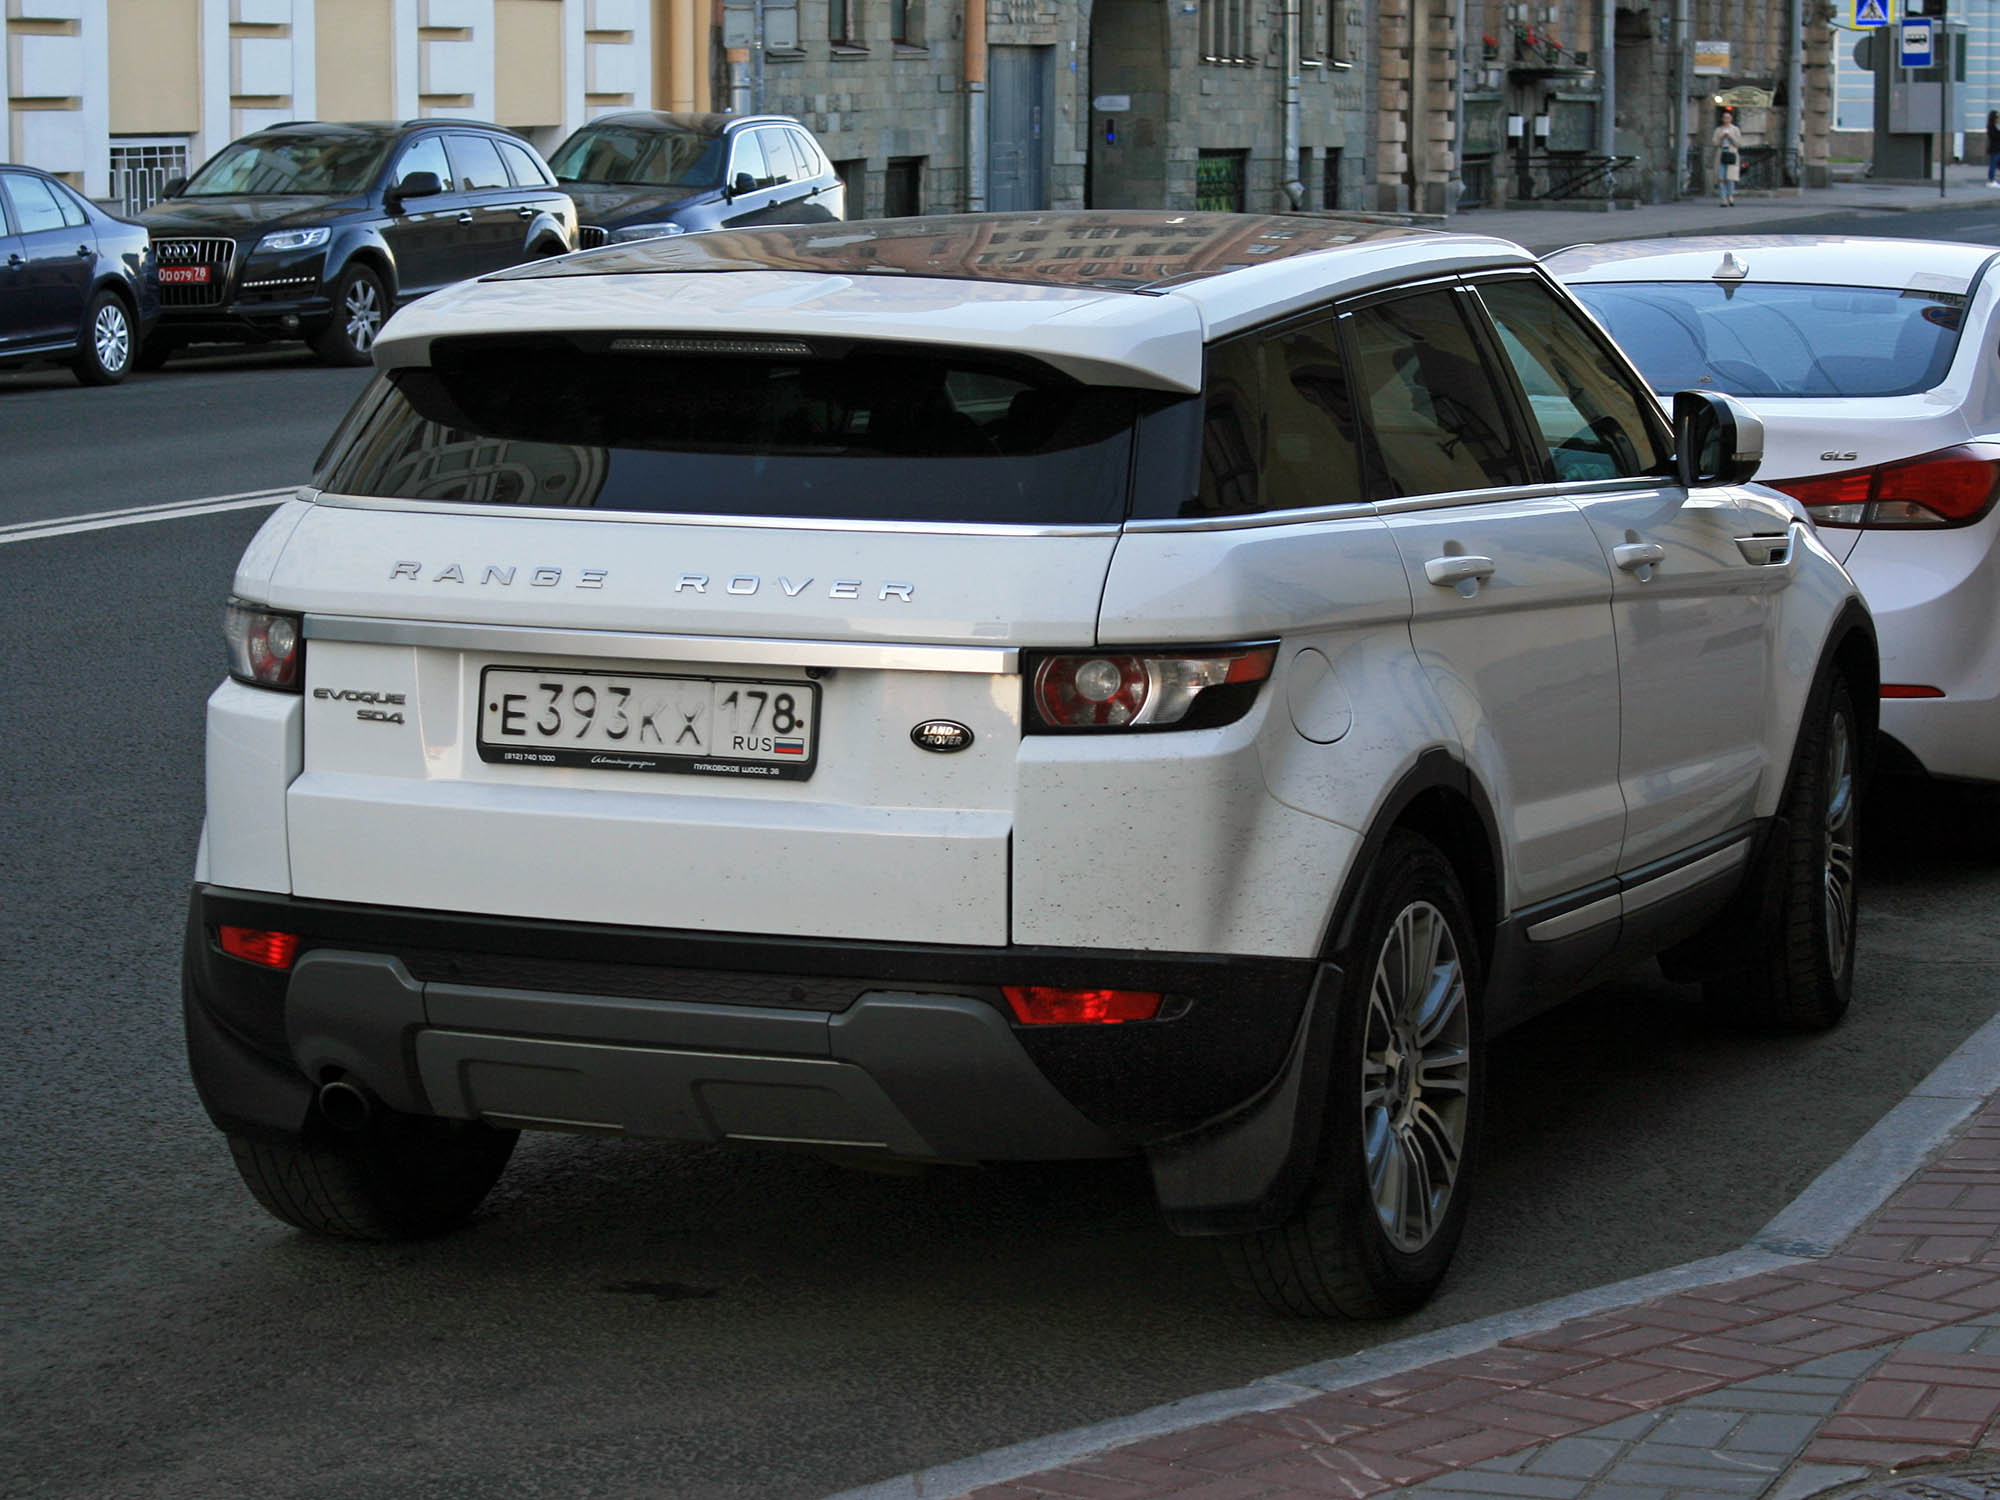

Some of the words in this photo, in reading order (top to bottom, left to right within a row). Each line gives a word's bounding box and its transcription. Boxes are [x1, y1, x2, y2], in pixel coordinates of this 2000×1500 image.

[1820, 450, 1858, 461] GLS
[389, 560, 608, 589] RANGE
[674, 572, 915, 602] ROVER
[313, 688, 407, 705] EVOQUE
[357, 709, 405, 725] SD4
[721, 690, 796, 735] 178
[923, 725, 954, 736] LAND
[732, 735, 772, 752] RUS
[926, 735, 963, 746] ROVER
